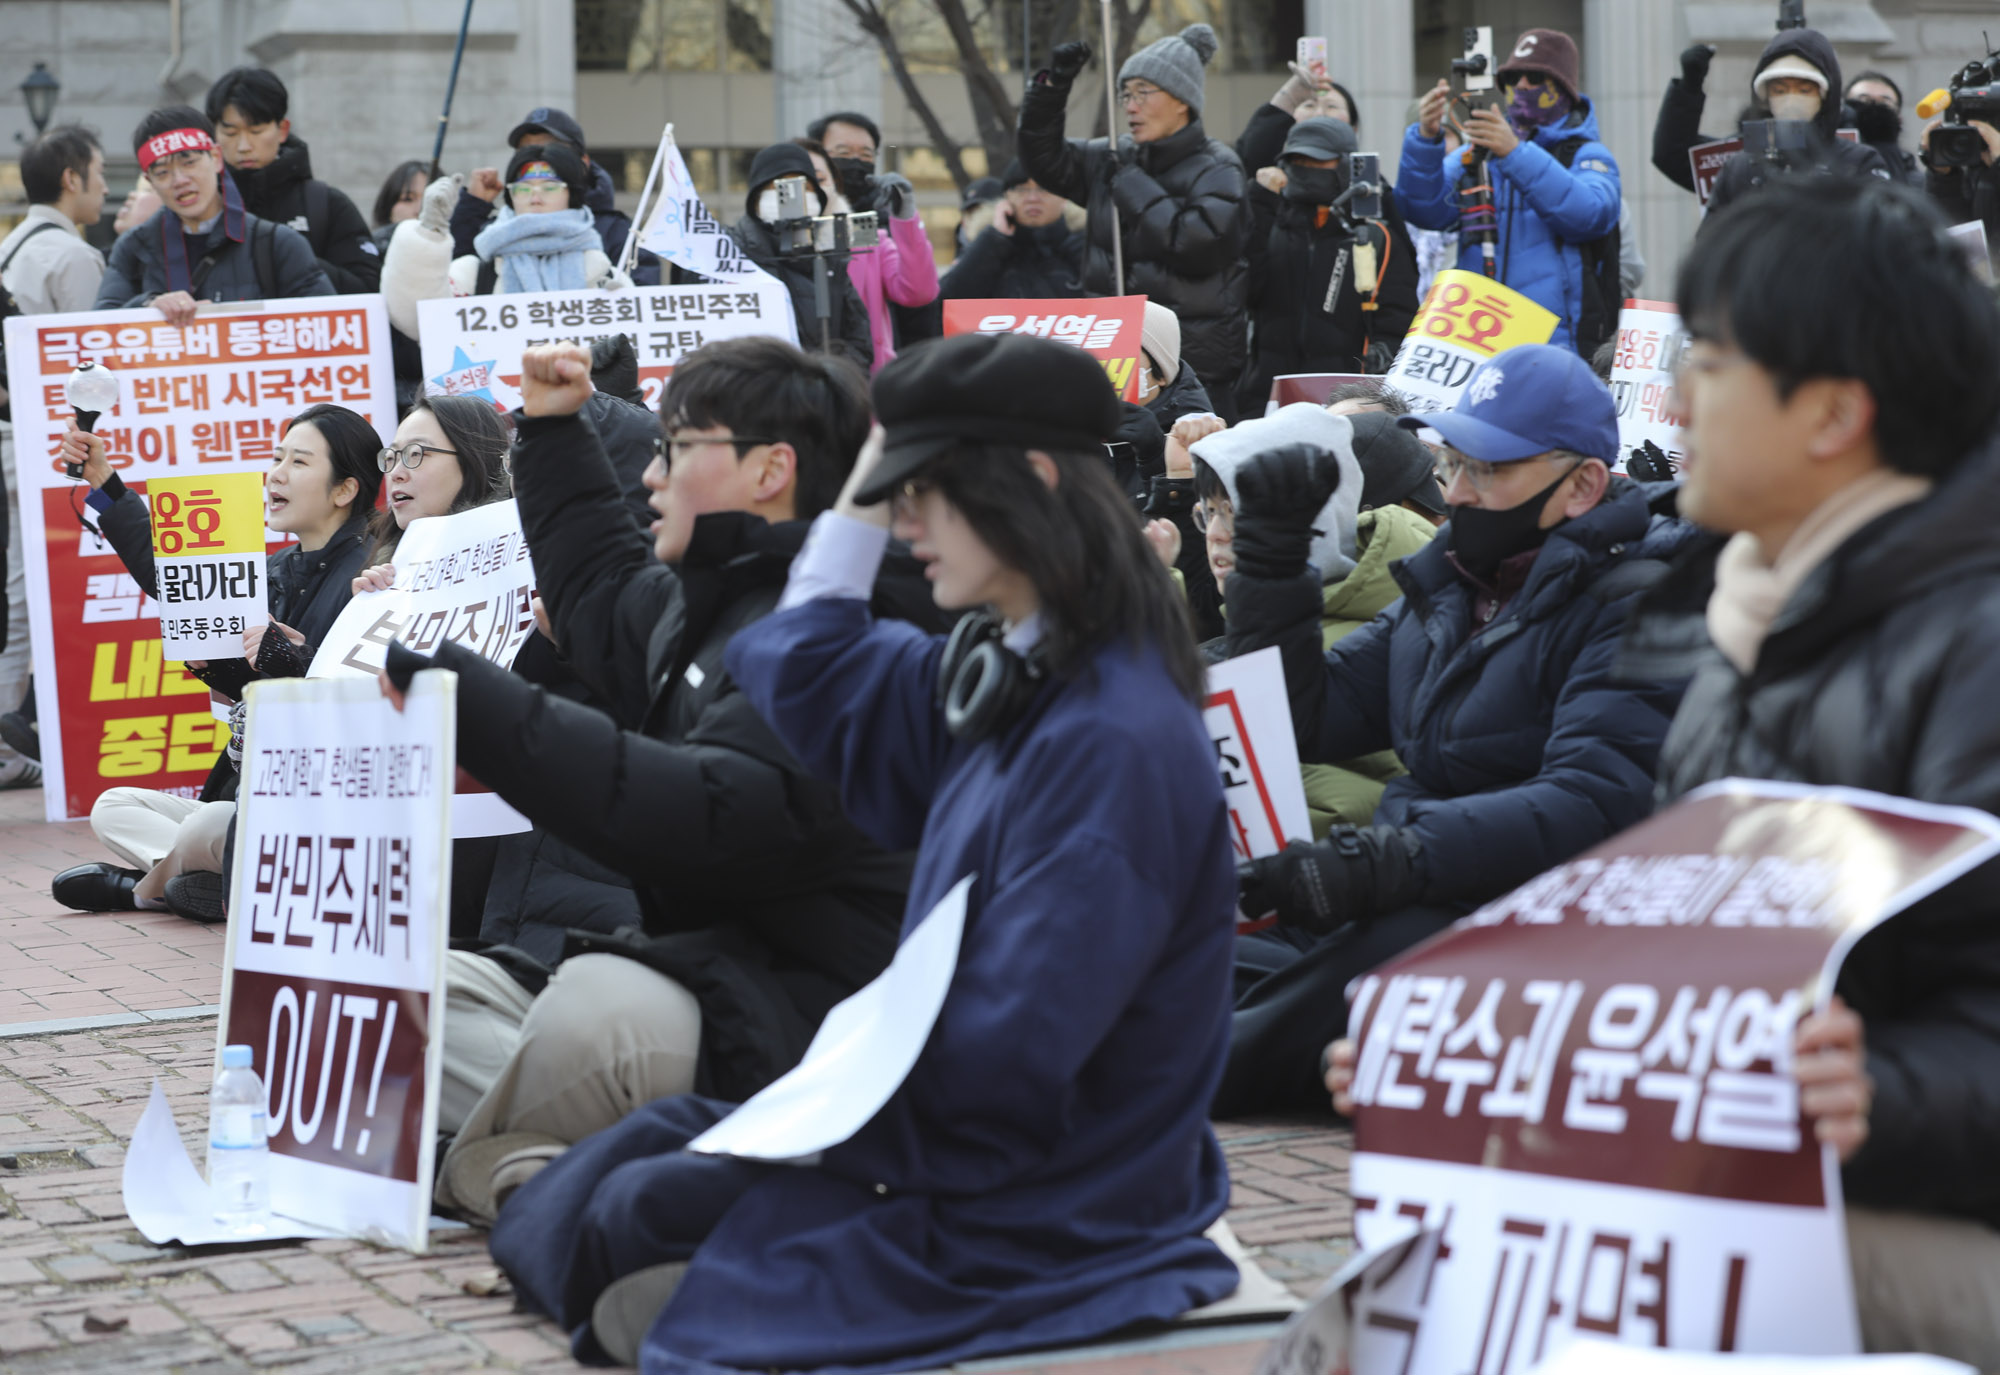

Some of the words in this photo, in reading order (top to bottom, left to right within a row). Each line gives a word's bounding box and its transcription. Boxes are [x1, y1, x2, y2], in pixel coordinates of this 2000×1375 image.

[1514, 34, 1538, 58] C
[455, 304, 519, 332] 12.6
[526, 296, 643, 328] 학생총회
[653, 292, 762, 322] 반민주적
[43, 323, 219, 364] 극우유튜버
[227, 315, 364, 356] 동원해서
[133, 374, 209, 415] 반대
[222, 364, 372, 406] 시국선언
[150, 489, 225, 554] 옹호
[164, 561, 259, 604] 물러가라
[168, 615, 246, 641] 민주동우회
[98, 712, 234, 778] 중단
[252, 748, 327, 797] 고려대학교
[330, 747, 382, 798] 학생들이
[250, 834, 412, 962] 반민주세력
[264, 985, 399, 1156] OUT!
[1562, 984, 1802, 1153] 윤석열
